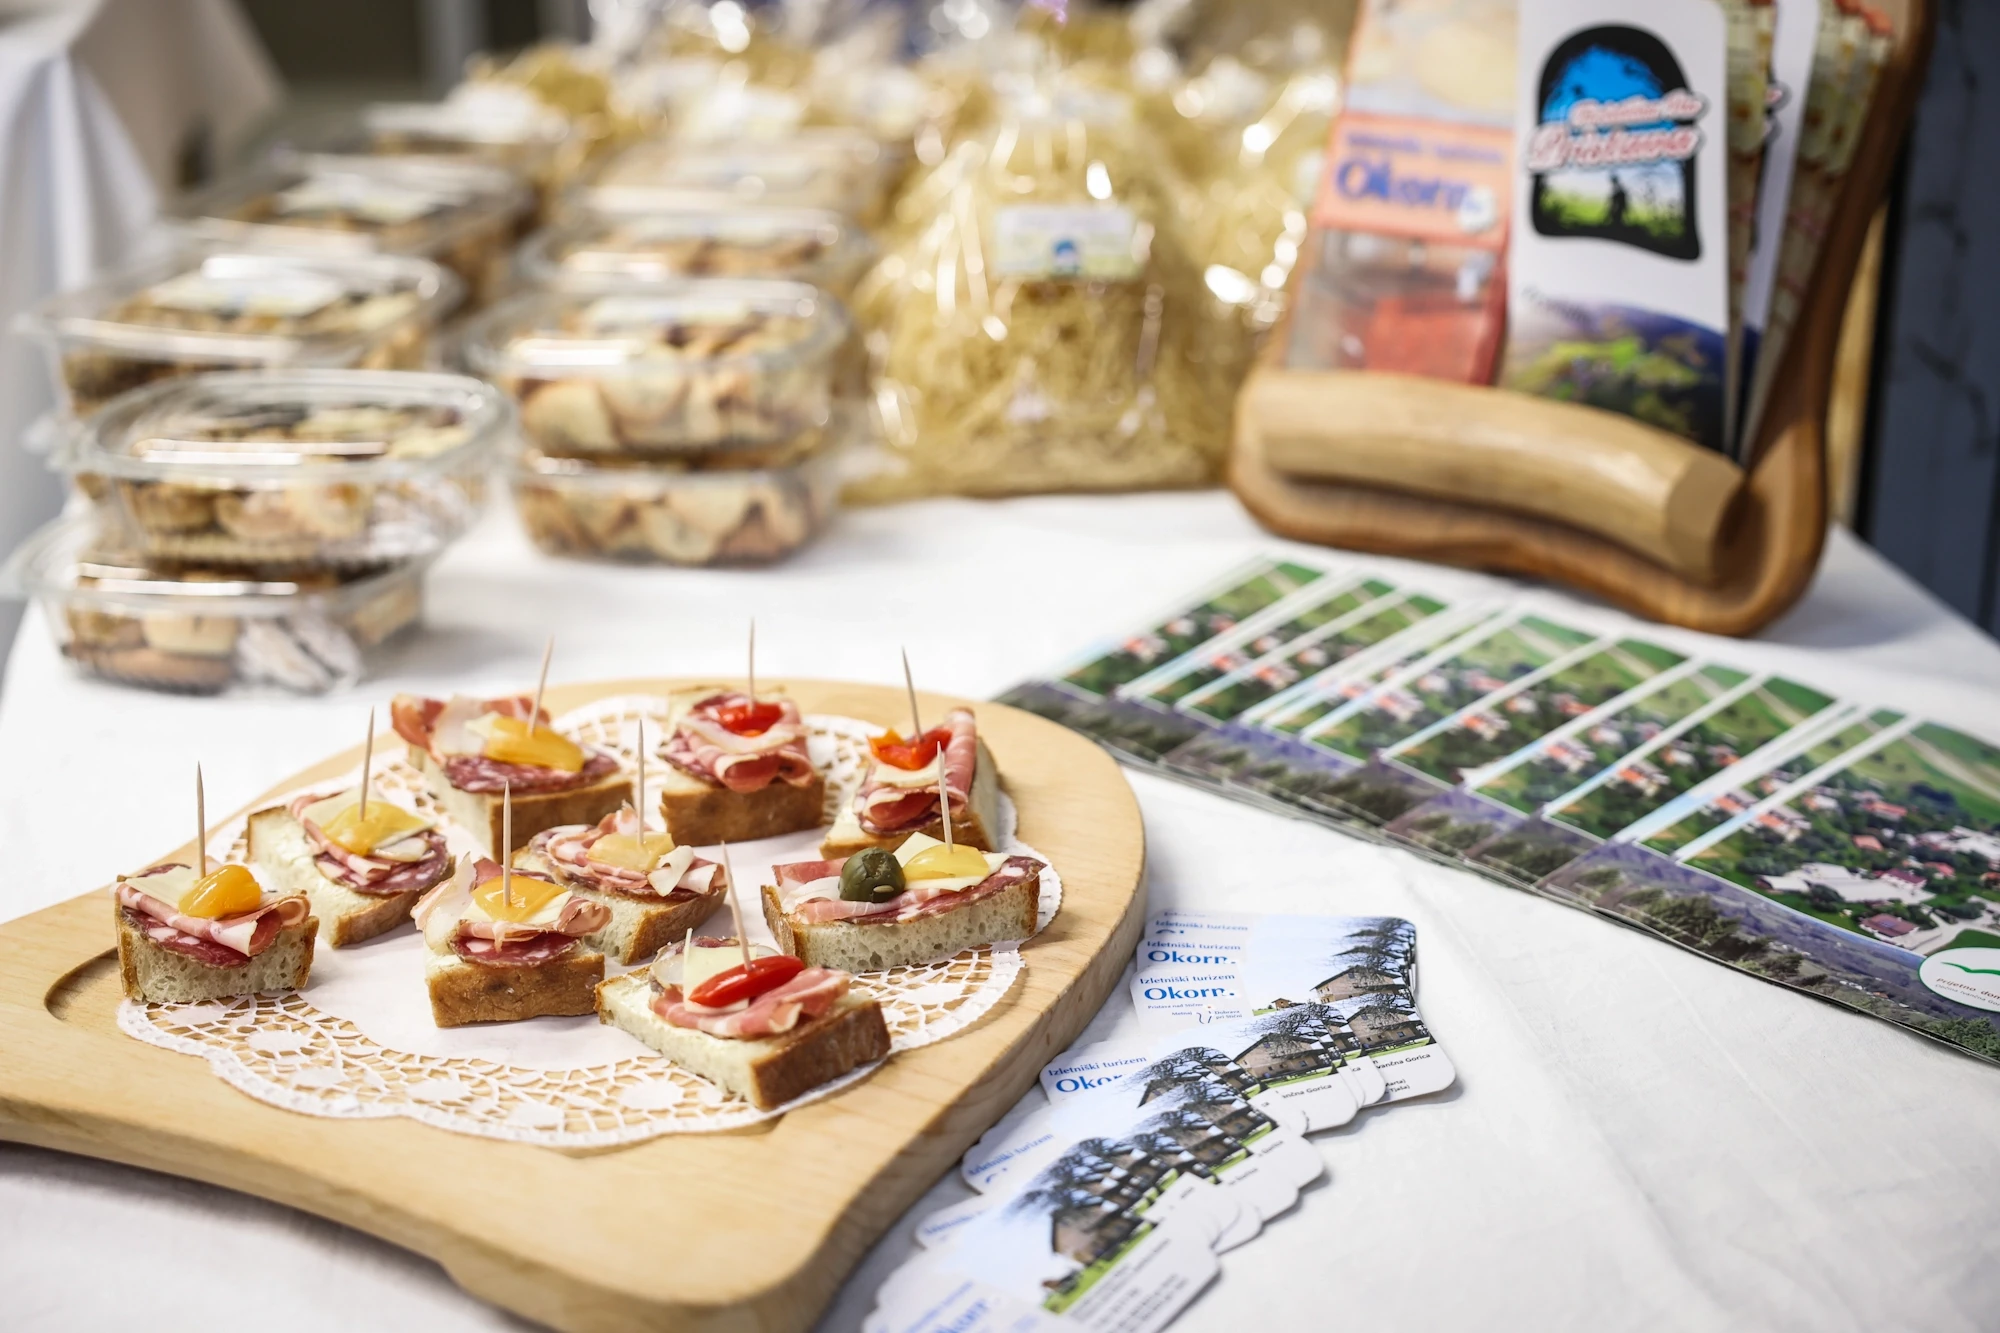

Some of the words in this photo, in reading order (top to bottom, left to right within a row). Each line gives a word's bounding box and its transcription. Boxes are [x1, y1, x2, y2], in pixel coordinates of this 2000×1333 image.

[1147, 941, 1195, 949] Izletniški
[1140, 975, 1189, 984] Izletniški
[1193, 973, 1235, 982] turizem
[1405, 1054, 1431, 1063] Gorica
[1048, 1062, 1100, 1076] Izletniški
[1103, 1056, 1147, 1068] turizem
[1306, 1084, 1332, 1093] Gorica
